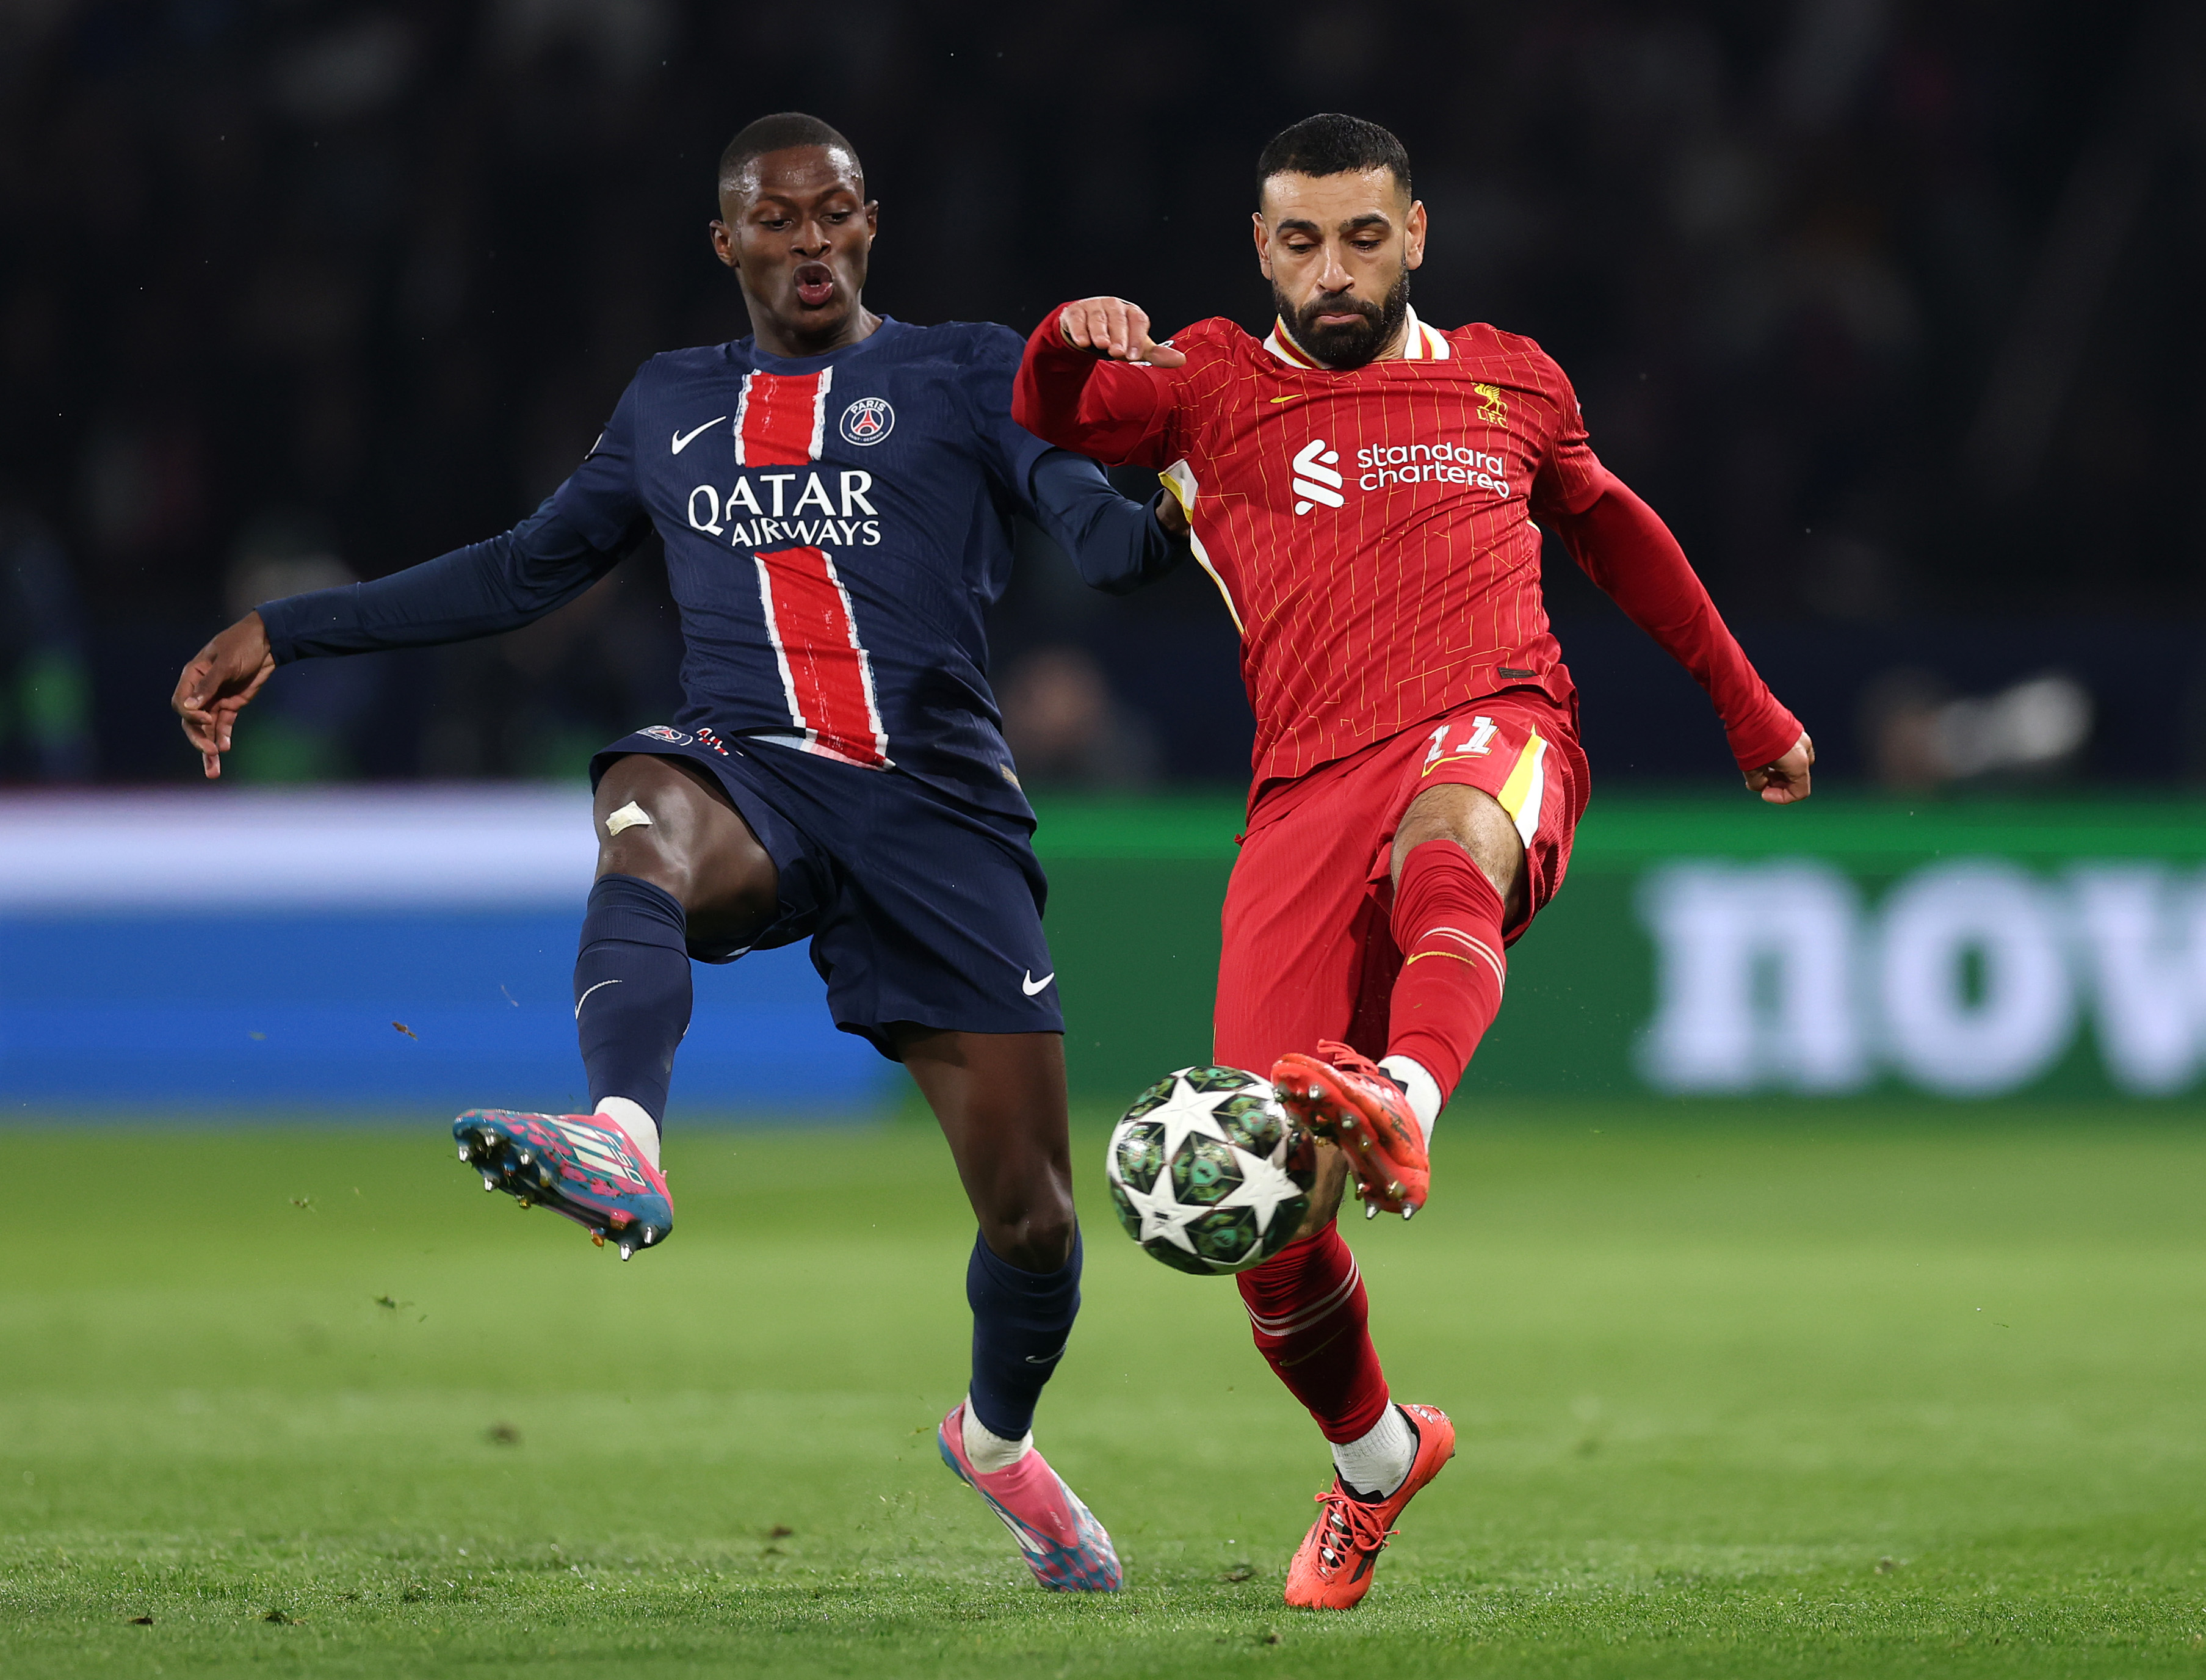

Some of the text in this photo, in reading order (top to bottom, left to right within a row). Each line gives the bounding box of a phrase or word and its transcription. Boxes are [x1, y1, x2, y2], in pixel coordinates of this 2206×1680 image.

[850, 400, 886, 414] PARIS
[1357, 441, 1503, 477] standard
[1359, 461, 1510, 499] chartered
[688, 469, 879, 536] QATAR
[732, 517, 881, 547] AIRWAYS
[1423, 715, 1500, 766] 11
